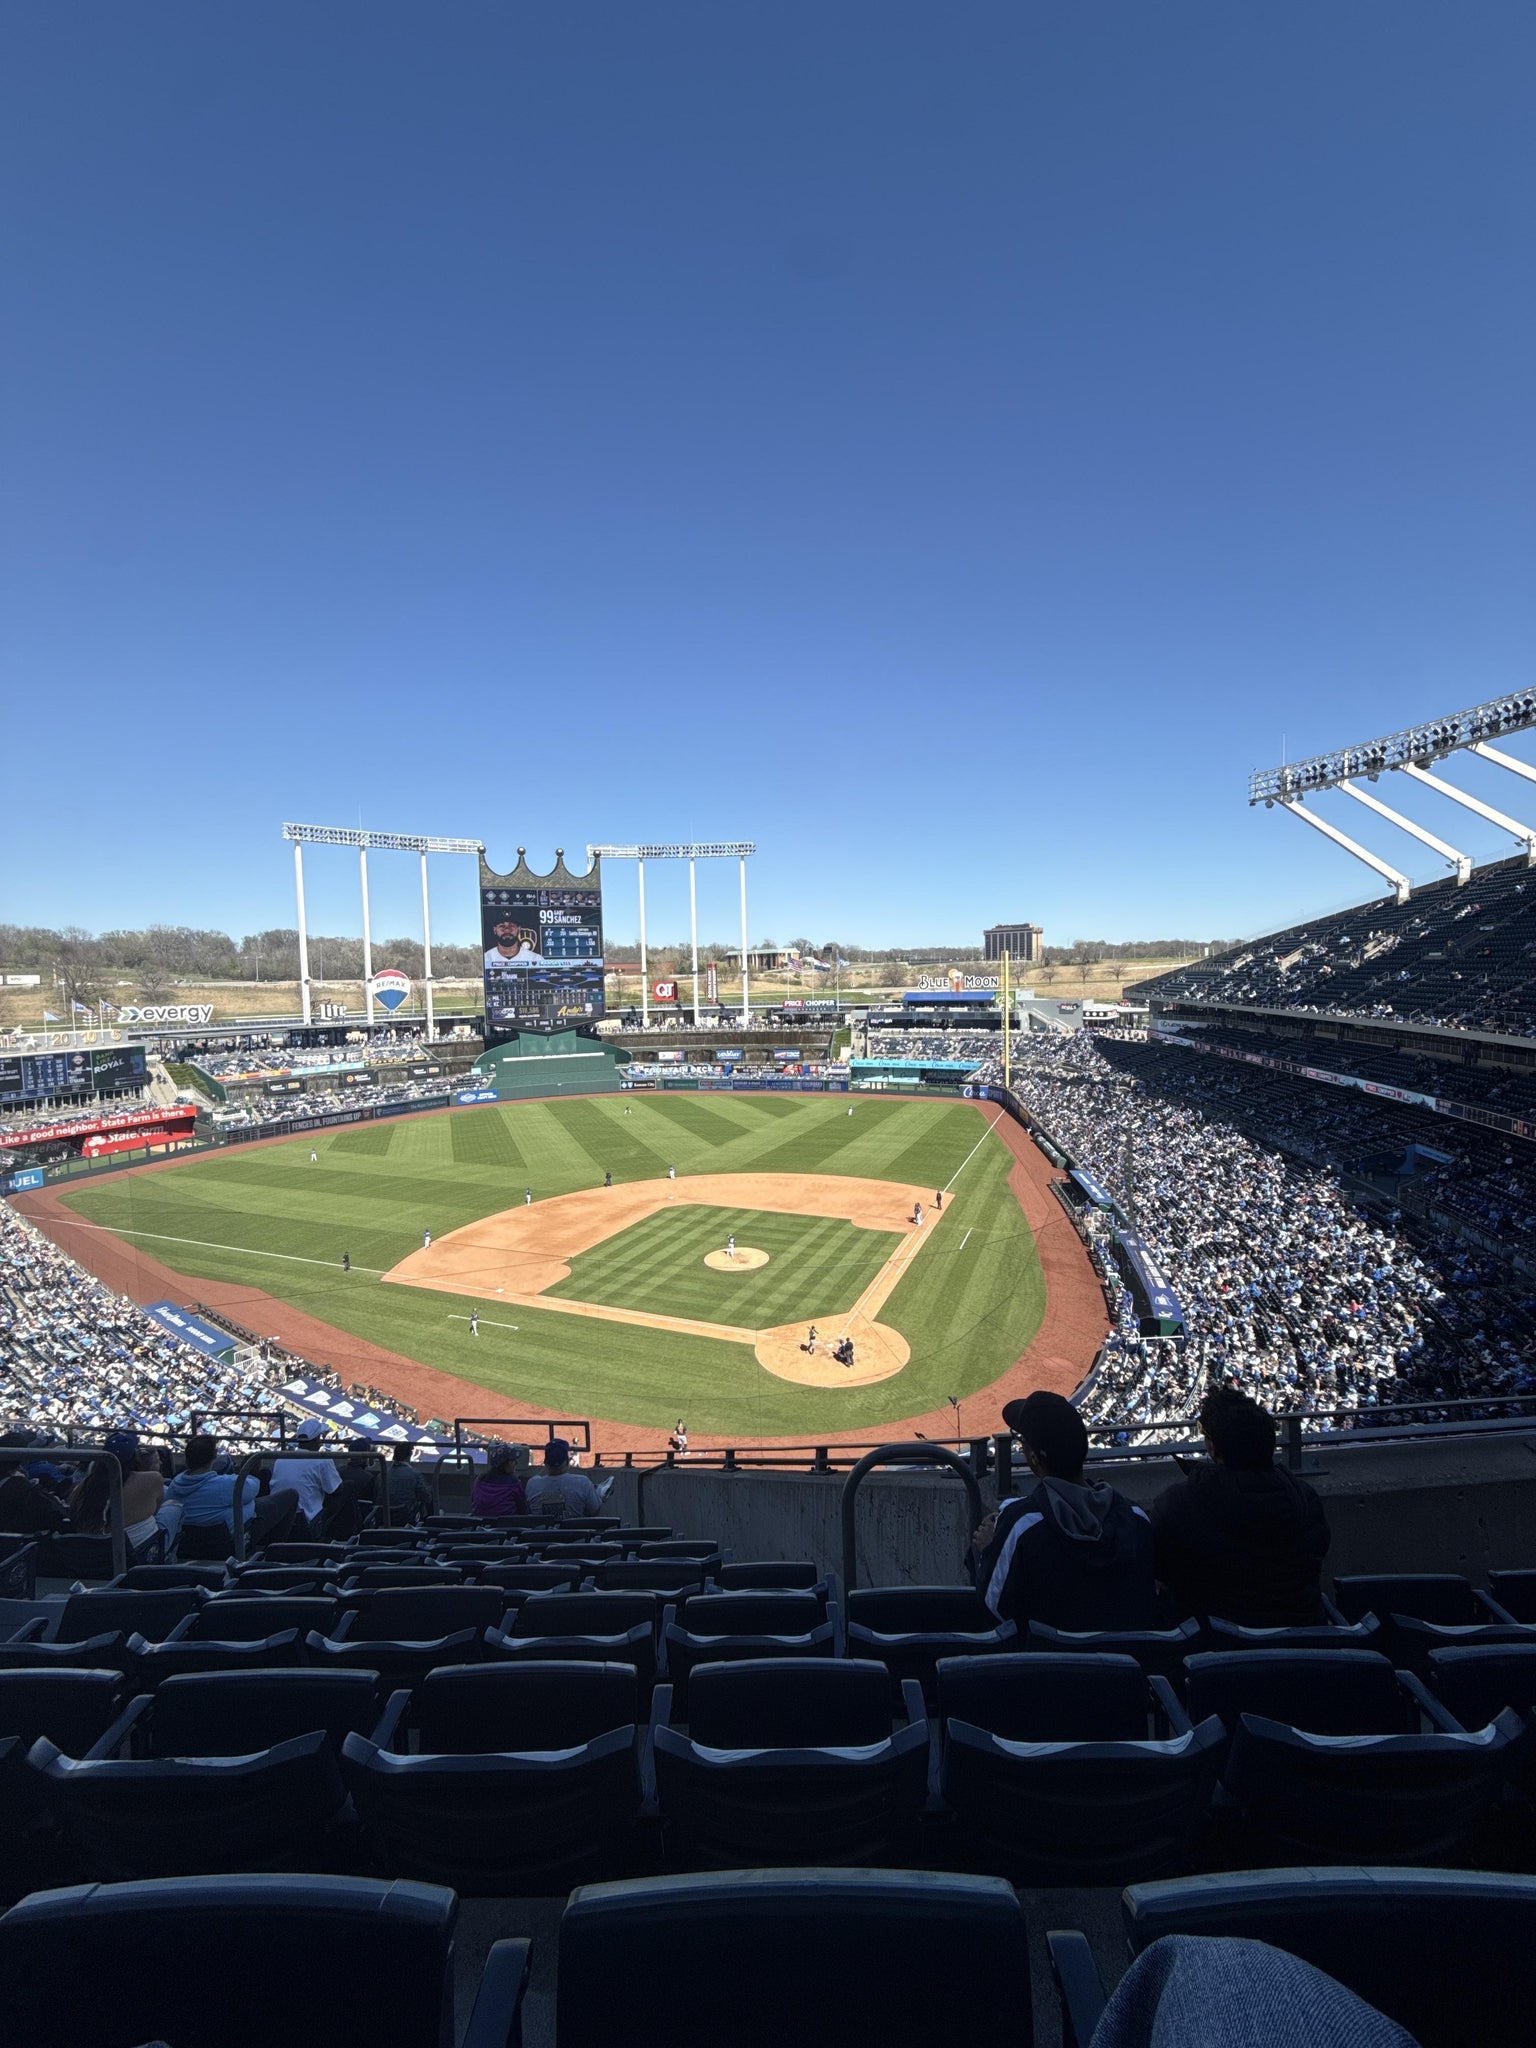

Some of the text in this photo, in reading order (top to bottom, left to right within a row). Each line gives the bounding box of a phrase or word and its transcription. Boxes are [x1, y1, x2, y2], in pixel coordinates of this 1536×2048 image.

[540, 910, 553, 924] 99
[376, 980, 406, 988] RE/MAX
[919, 976, 998, 989] BLUE MOON
[655, 983, 674, 998] QT
[143, 1006, 211, 1021] evergy
[320, 1003, 347, 1020] Lite
[53, 1033, 70, 1046] 20
[81, 1031, 97, 1044] 10
[111, 1030, 121, 1040] 5
[93, 1057, 125, 1074] ROYAL
[644, 1065, 688, 1075] FOUNTAIN
[0, 1136, 20, 1144] Like
[30, 1130, 55, 1143] good
[56, 1123, 100, 1135] neighbor,
[101, 1117, 126, 1128] State
[127, 1114, 150, 1123] Farm
[152, 1112, 160, 1120] is
[161, 1108, 186, 1118] there.
